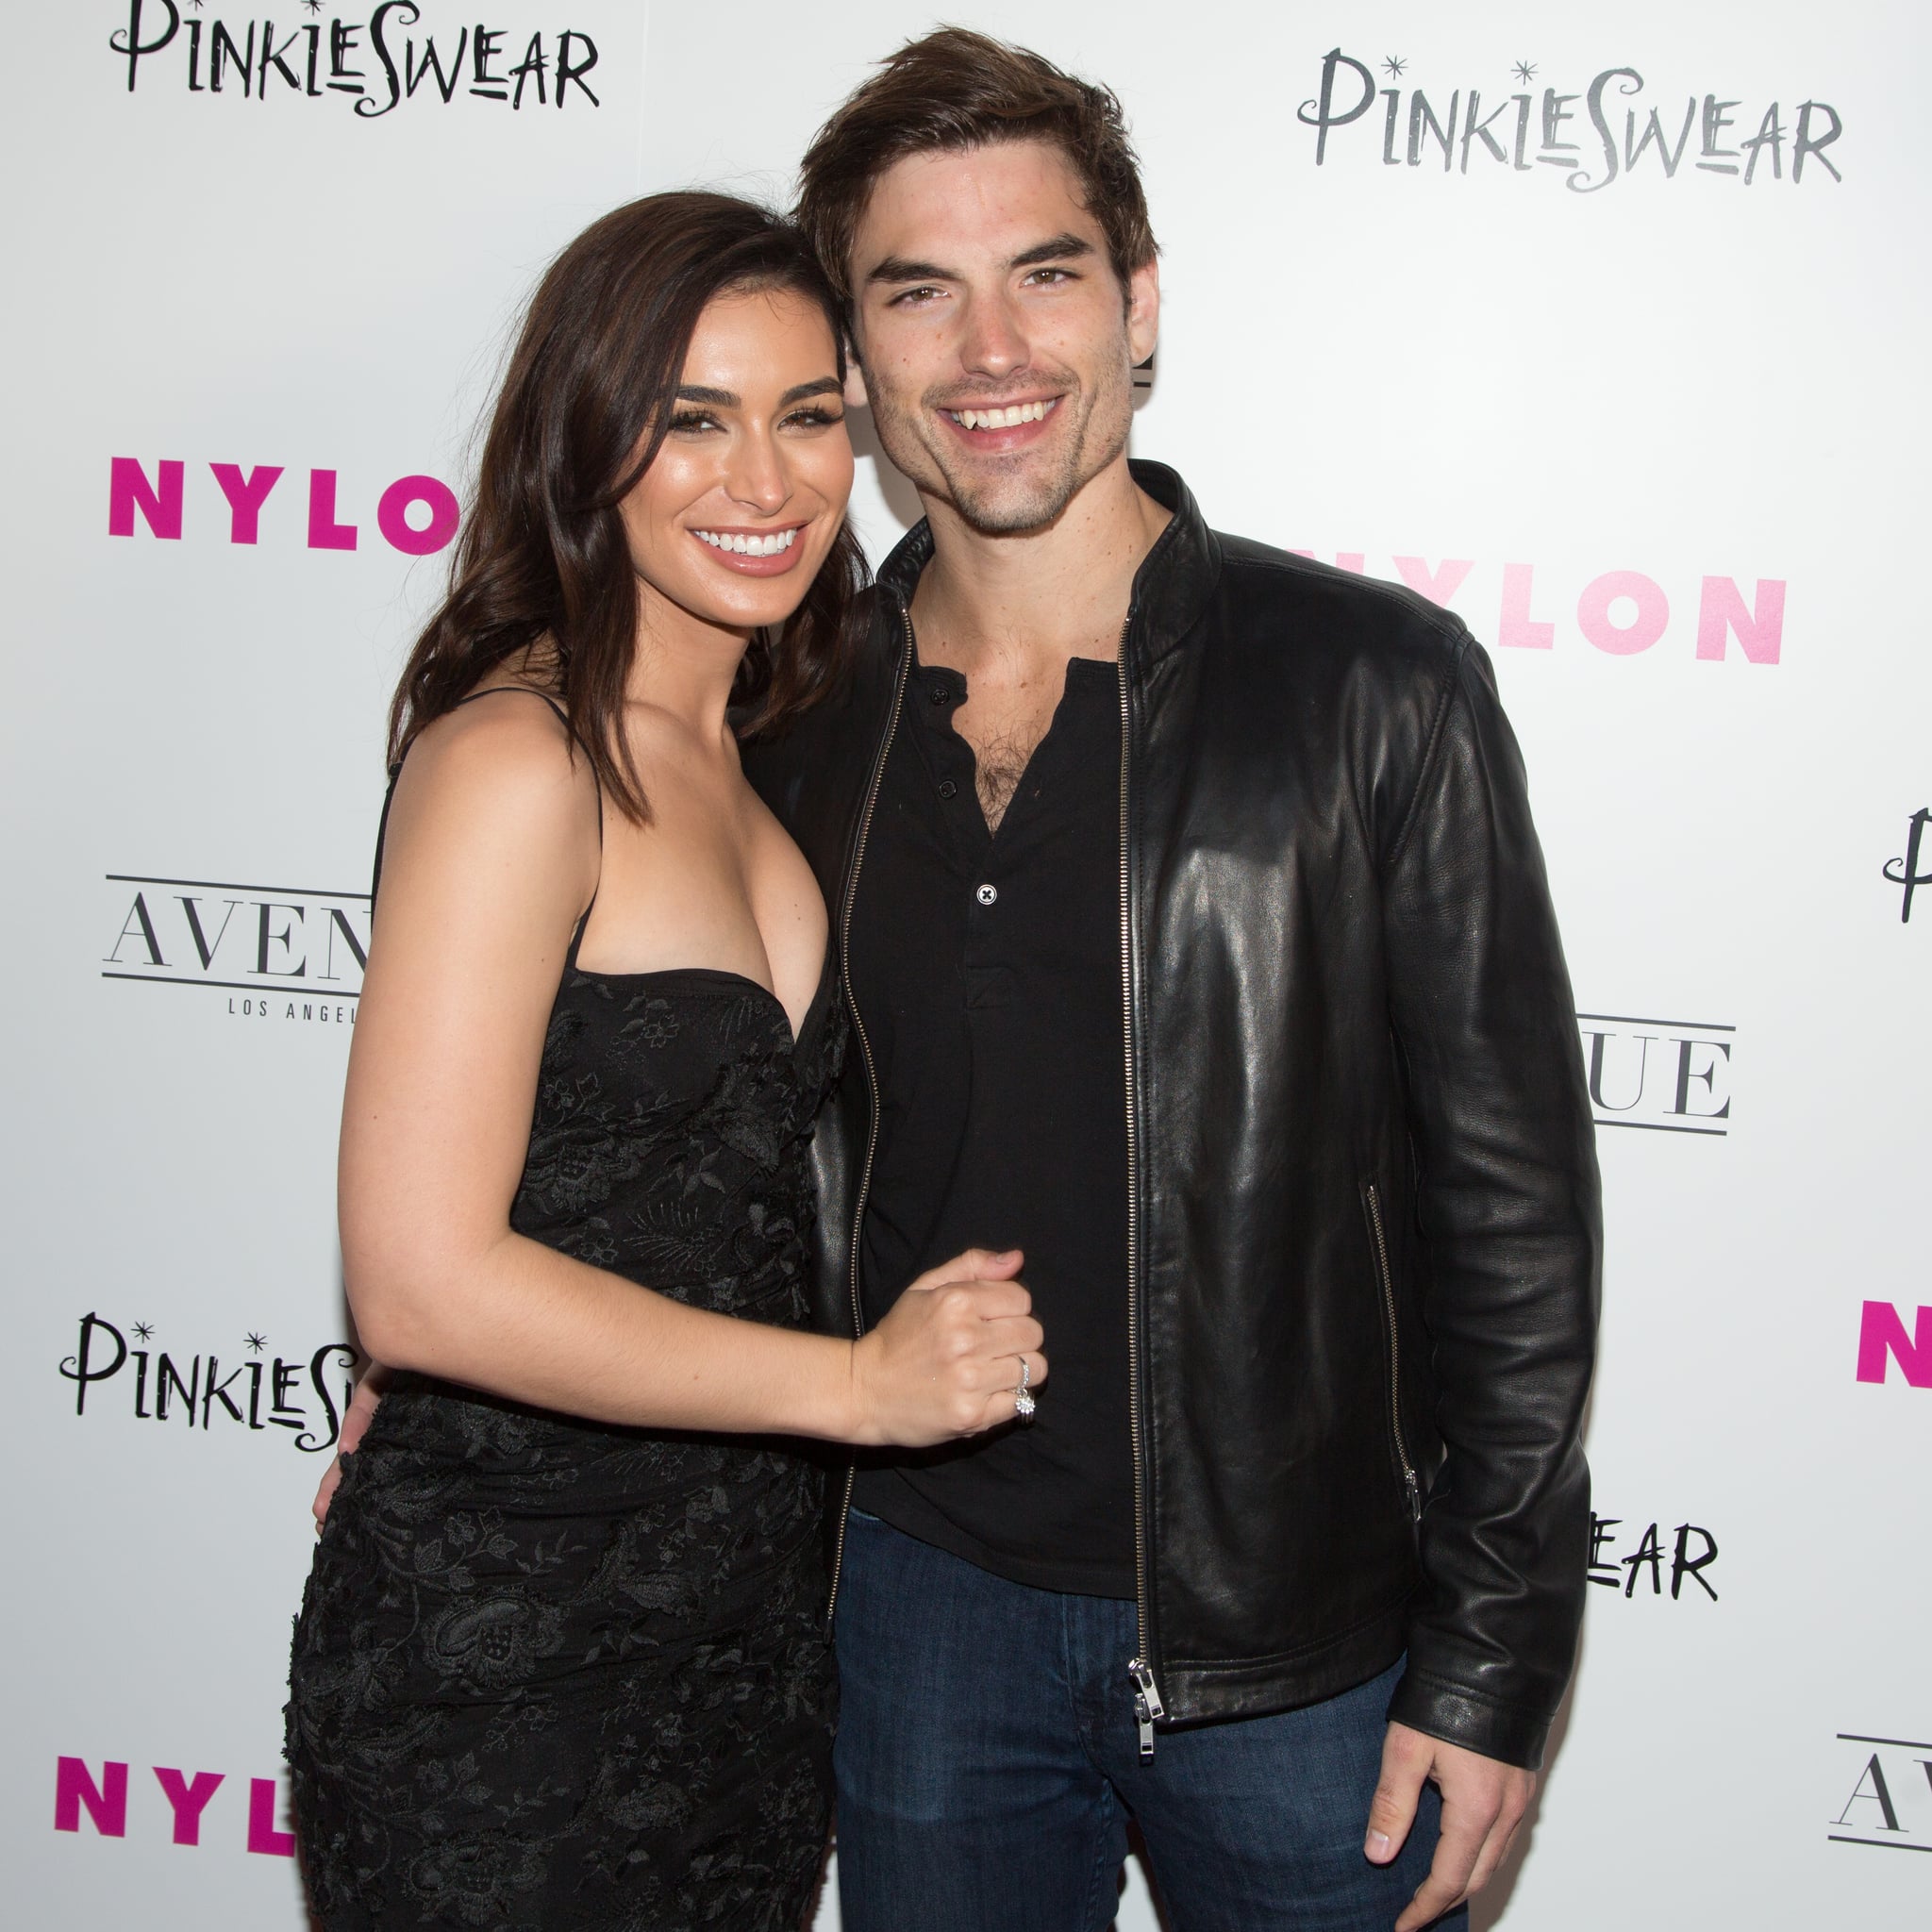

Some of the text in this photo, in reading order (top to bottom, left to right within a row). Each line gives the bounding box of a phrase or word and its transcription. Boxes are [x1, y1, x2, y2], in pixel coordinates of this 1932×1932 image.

[108, 457, 460, 557] NYLO
[1284, 548, 1788, 665] YLON
[228, 997, 356, 1024] LOS ANGEL
[1582, 1031, 1731, 1120] UE
[59, 1311, 359, 1453] PINKIES
[54, 1756, 295, 1858] NYL
[1828, 1752, 1932, 1833] A
